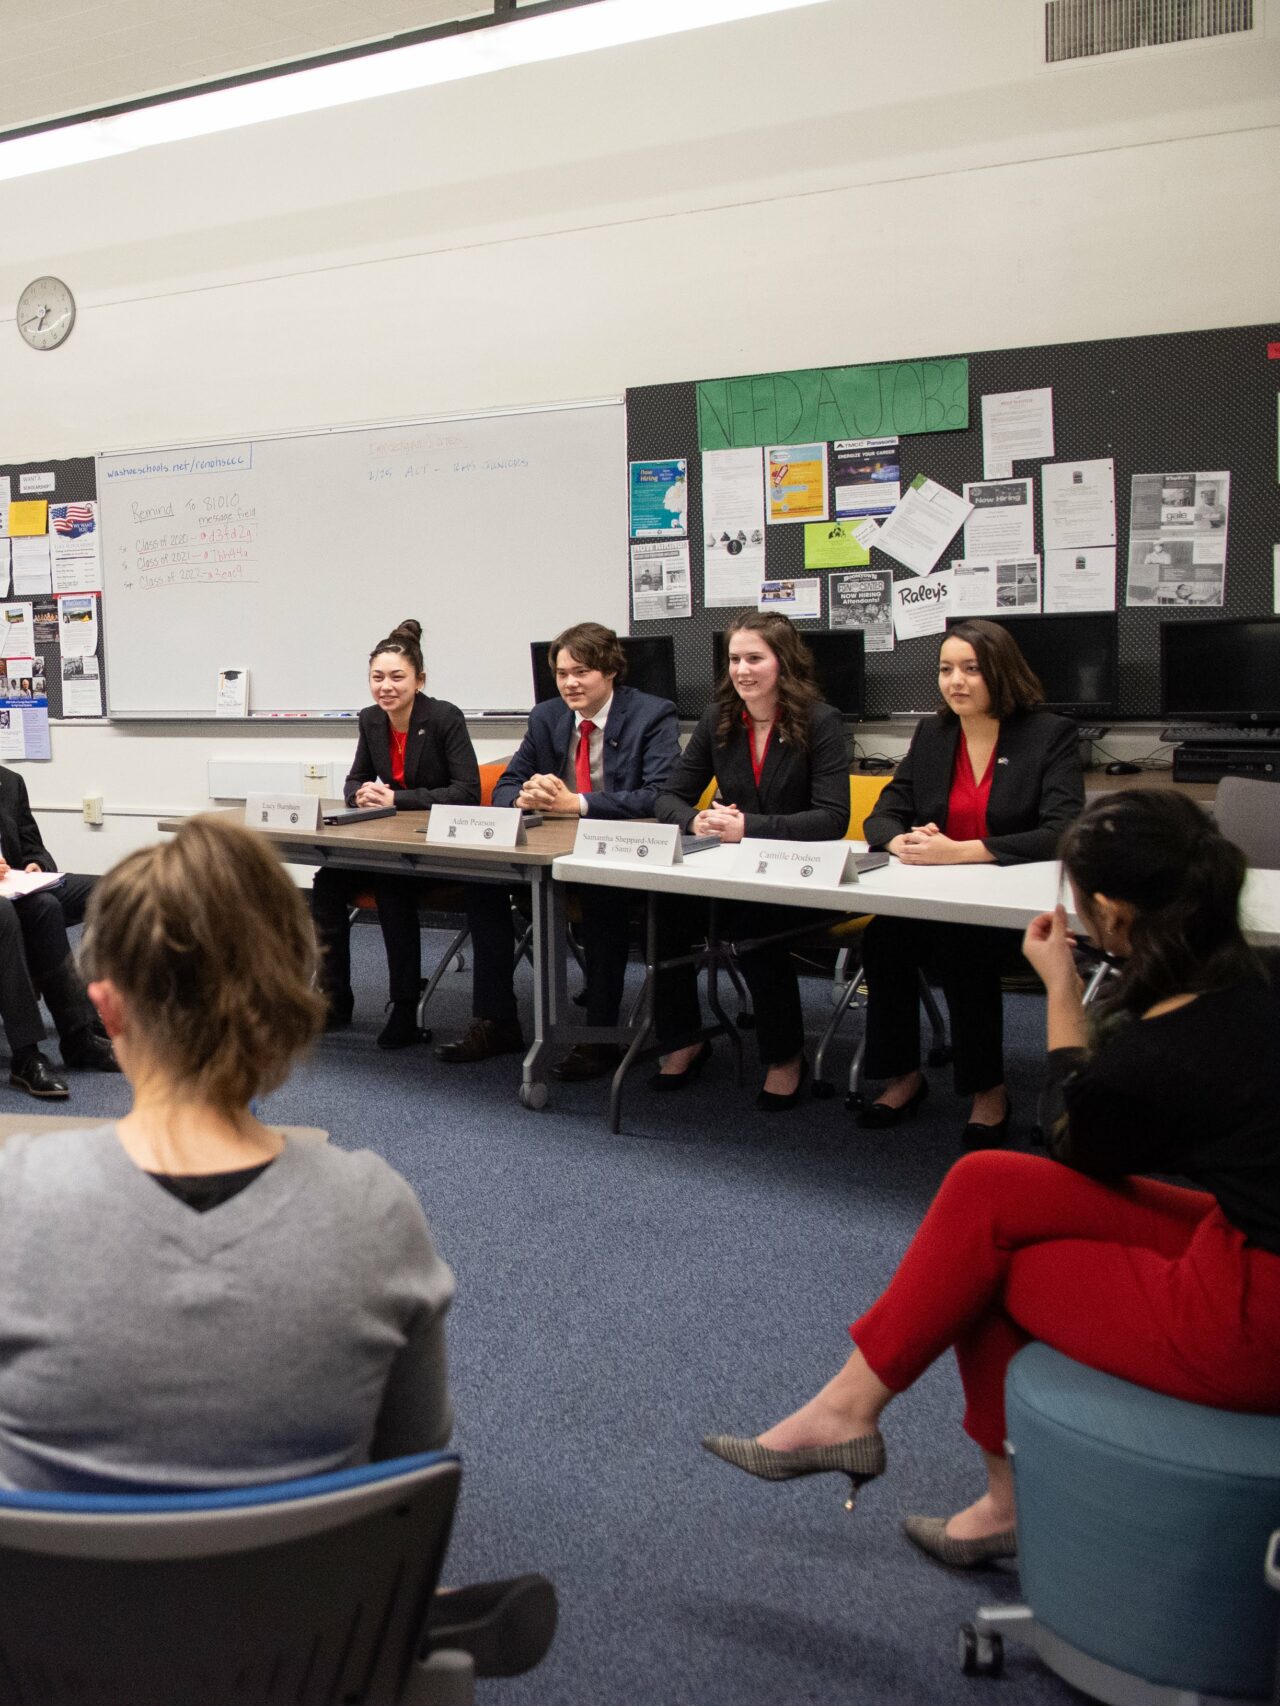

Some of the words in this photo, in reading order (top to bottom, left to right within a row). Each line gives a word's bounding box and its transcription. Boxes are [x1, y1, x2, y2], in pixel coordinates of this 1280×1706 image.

[813, 372, 850, 441] A
[852, 360, 967, 437] JOB?
[995, 495, 1021, 503] Hiring
[131, 501, 174, 521] Remind
[202, 492, 240, 512] 81010
[198, 513, 233, 525] message
[135, 539, 159, 552] Class
[136, 556, 159, 570] Class
[898, 582, 948, 606] Raley's
[583, 833, 614, 841] Samantha
[760, 850, 790, 860] Camille
[791, 852, 822, 863] Dodson
